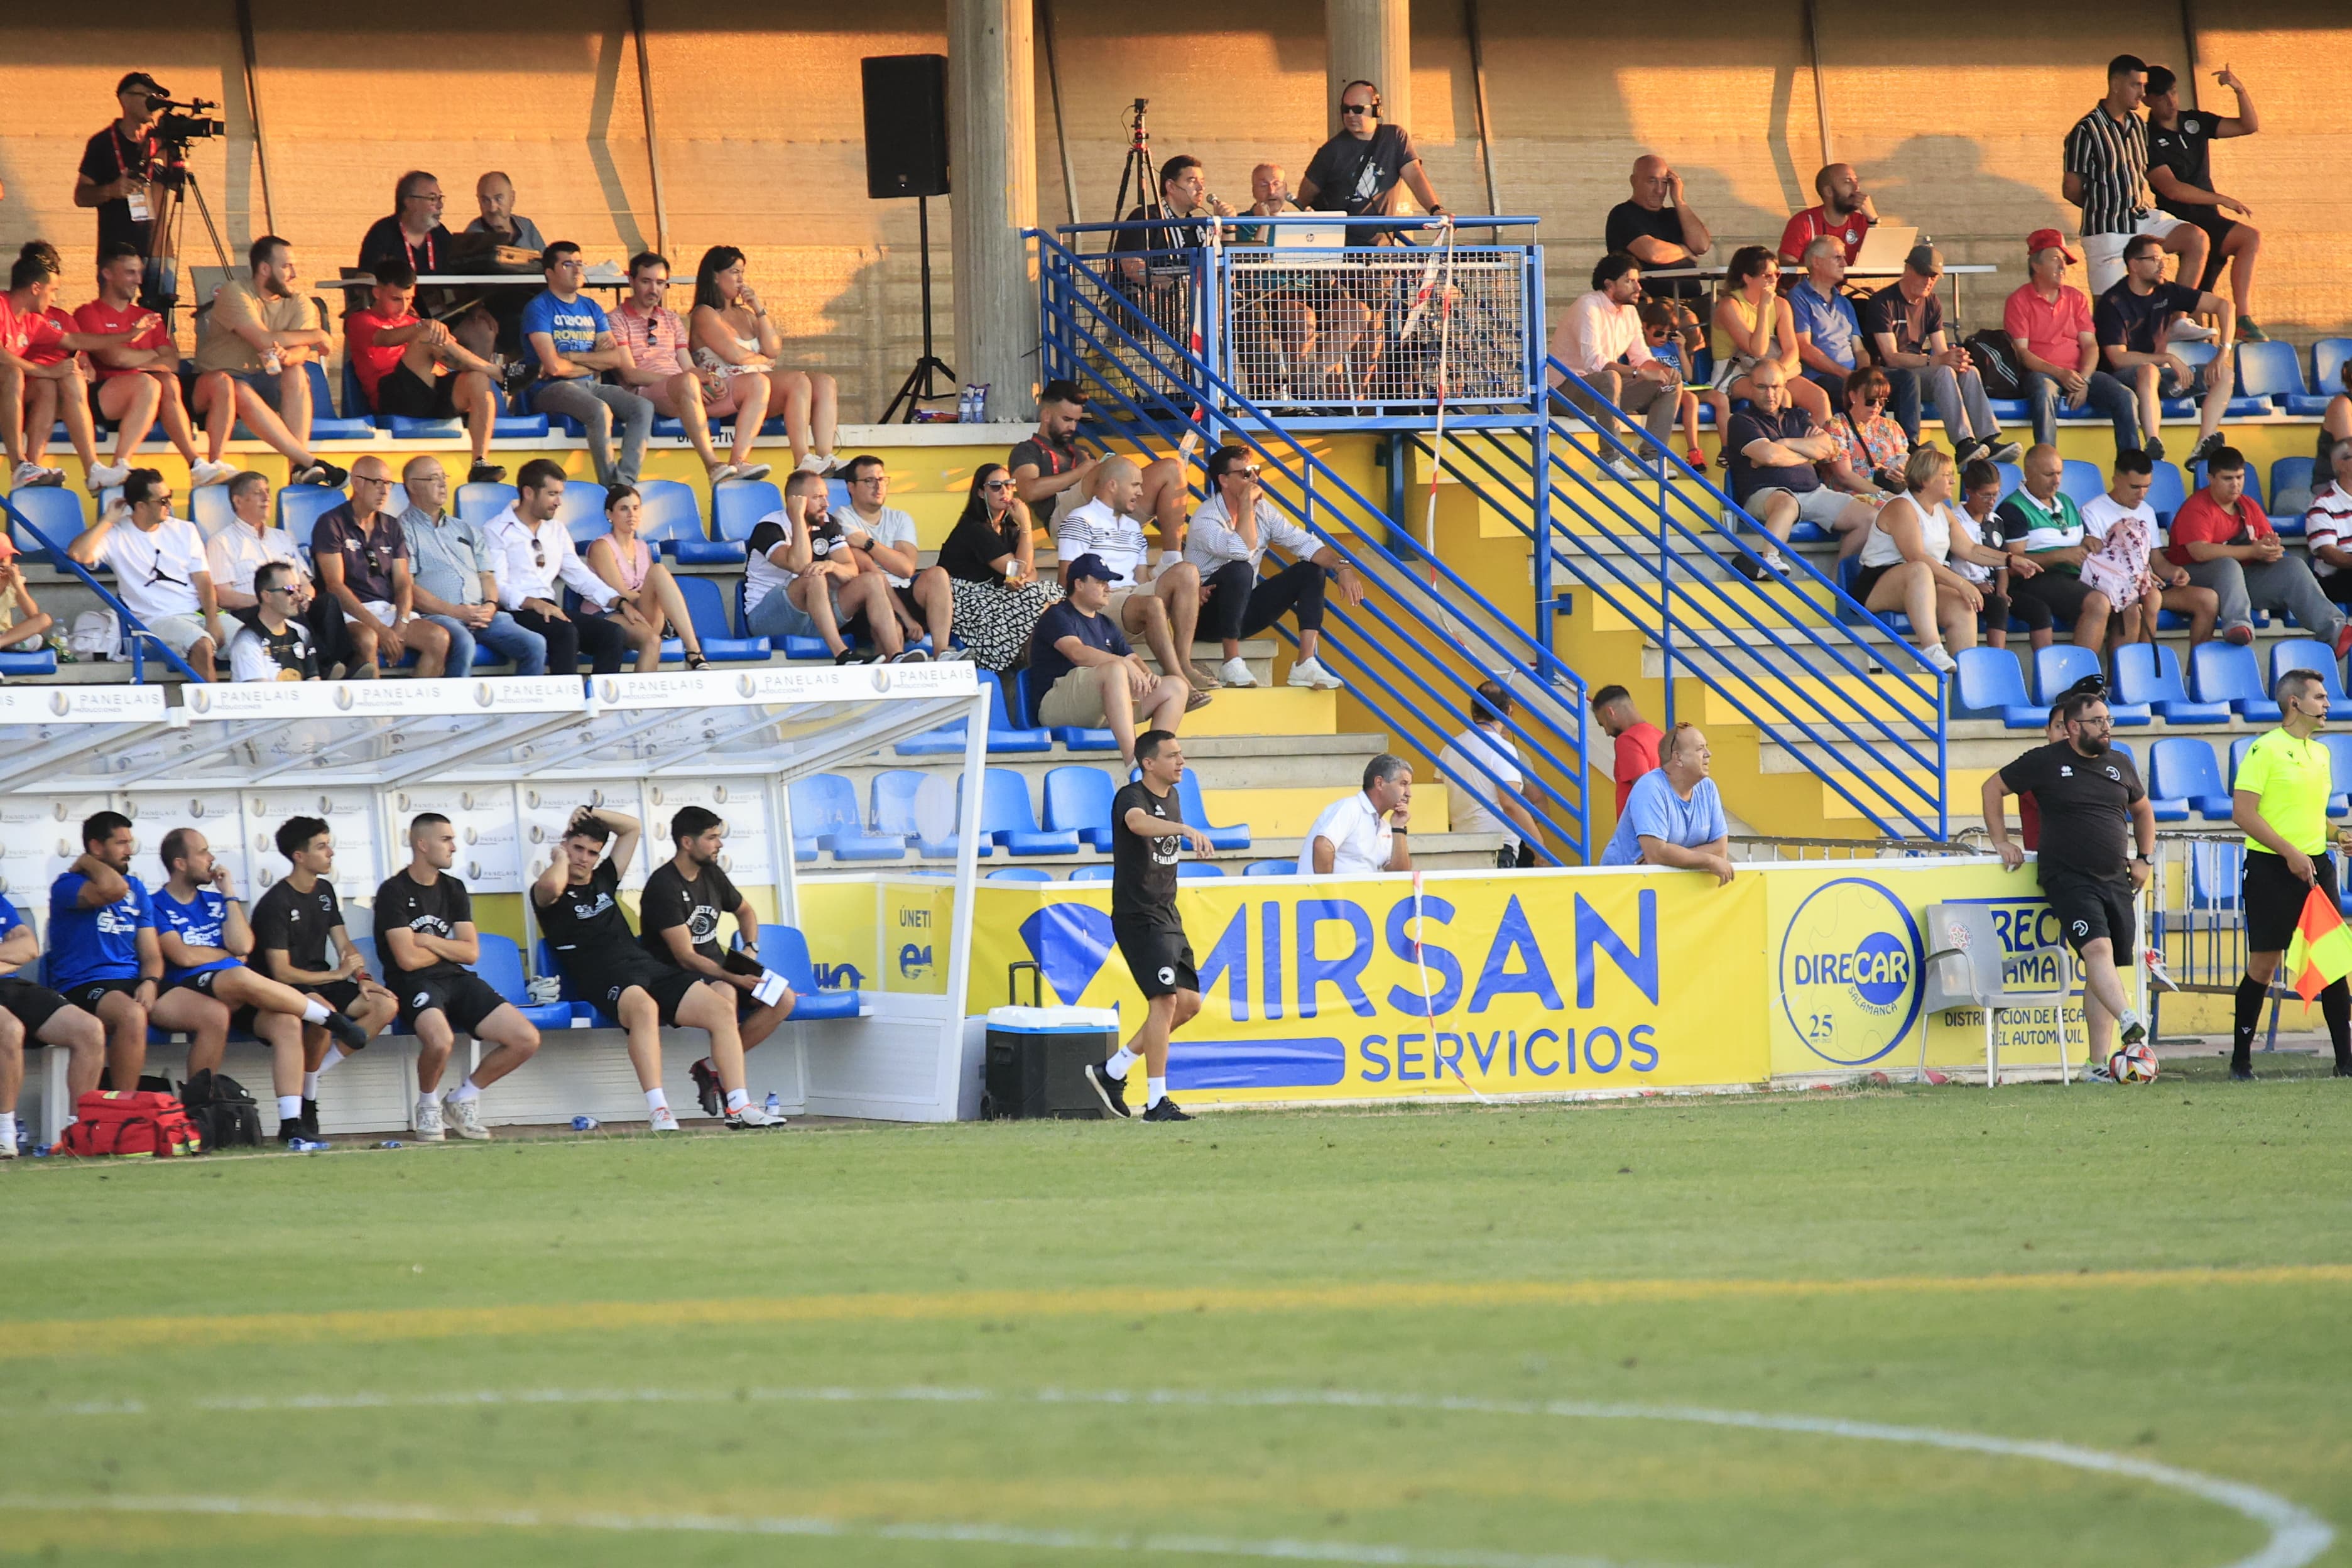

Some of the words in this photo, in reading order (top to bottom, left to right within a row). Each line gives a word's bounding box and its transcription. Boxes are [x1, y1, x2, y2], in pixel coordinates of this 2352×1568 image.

[765, 673, 839, 686] PANELAIS
[899, 668, 973, 682] PANELAIS
[503, 684, 580, 699] PANELAIS
[629, 679, 704, 692] PANELAIS
[80, 694, 161, 705] PANELAIS
[220, 690, 300, 704] PANELAIS
[362, 687, 441, 700] PANELAIS
[1795, 951, 1908, 985] DIRECAR
[1848, 986, 1898, 1016] SALAMANCA
[1945, 1007, 2030, 1027] DISTRICIÓN
[2034, 1009, 2050, 1024] DE
[1809, 1015, 1832, 1037] 25
[2012, 1029, 2084, 1046] AUTOMVIL
[1360, 1024, 1659, 1082] SERVICIOS
